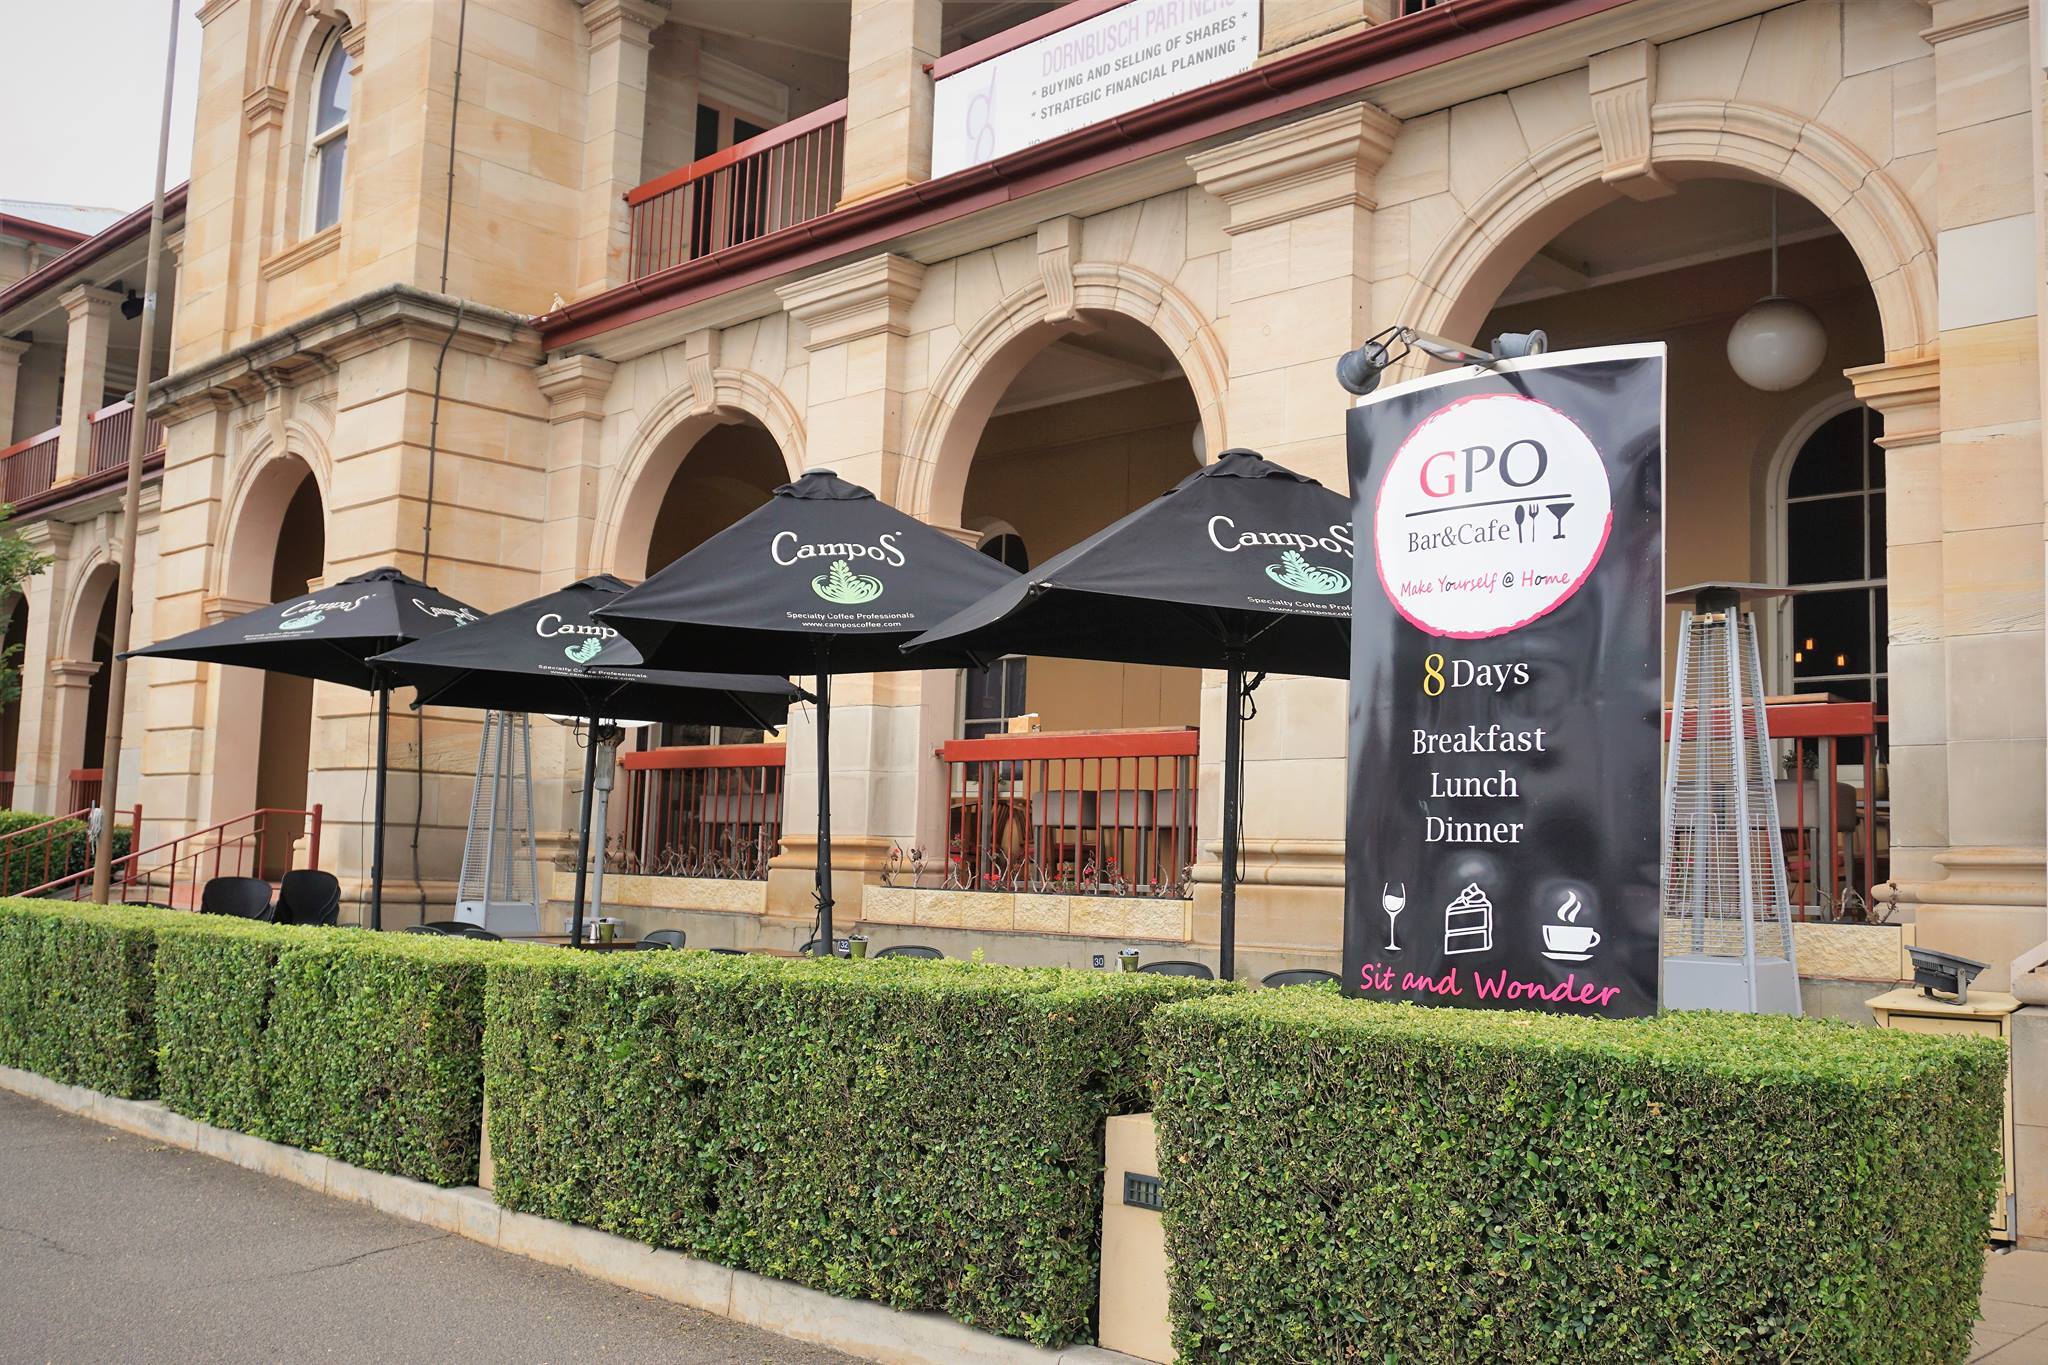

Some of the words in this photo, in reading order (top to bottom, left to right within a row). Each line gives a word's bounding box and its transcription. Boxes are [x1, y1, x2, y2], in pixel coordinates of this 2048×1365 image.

[1042, 15, 1139, 77] DORNBUSCH
[1146, 0, 1234, 37] PARTNE
[1041, 73, 1083, 98] BUYING
[1087, 63, 1111, 82] AND
[1114, 44, 1161, 72] SELLING
[1166, 35, 1181, 52] OF
[1185, 16, 1236, 45] SHARES
[1040, 88, 1101, 120] STRATEGIC
[1105, 64, 1167, 97] FINANCIAL
[1172, 39, 1235, 73] PLANNING
[1420, 439, 1548, 498] GPO
[1408, 519, 1510, 552] Bar&Cafe
[1400, 580, 1433, 597] Make
[1438, 572, 1498, 594] Yourself
[1502, 572, 1514, 588] @
[1522, 569, 1570, 587] Home
[536, 613, 619, 640] Camp
[786, 611, 825, 621] Specialty
[857, 612, 915, 620] Professionals
[1423, 653, 1446, 697] 8
[1451, 659, 1530, 692] Days
[1412, 725, 1547, 755] Breakfast
[1430, 770, 1520, 798] Lunch
[1425, 817, 1524, 844] Dinner
[1360, 962, 1396, 992] Sit
[1402, 968, 1463, 996] and
[1474, 969, 1621, 1006] Wonder
